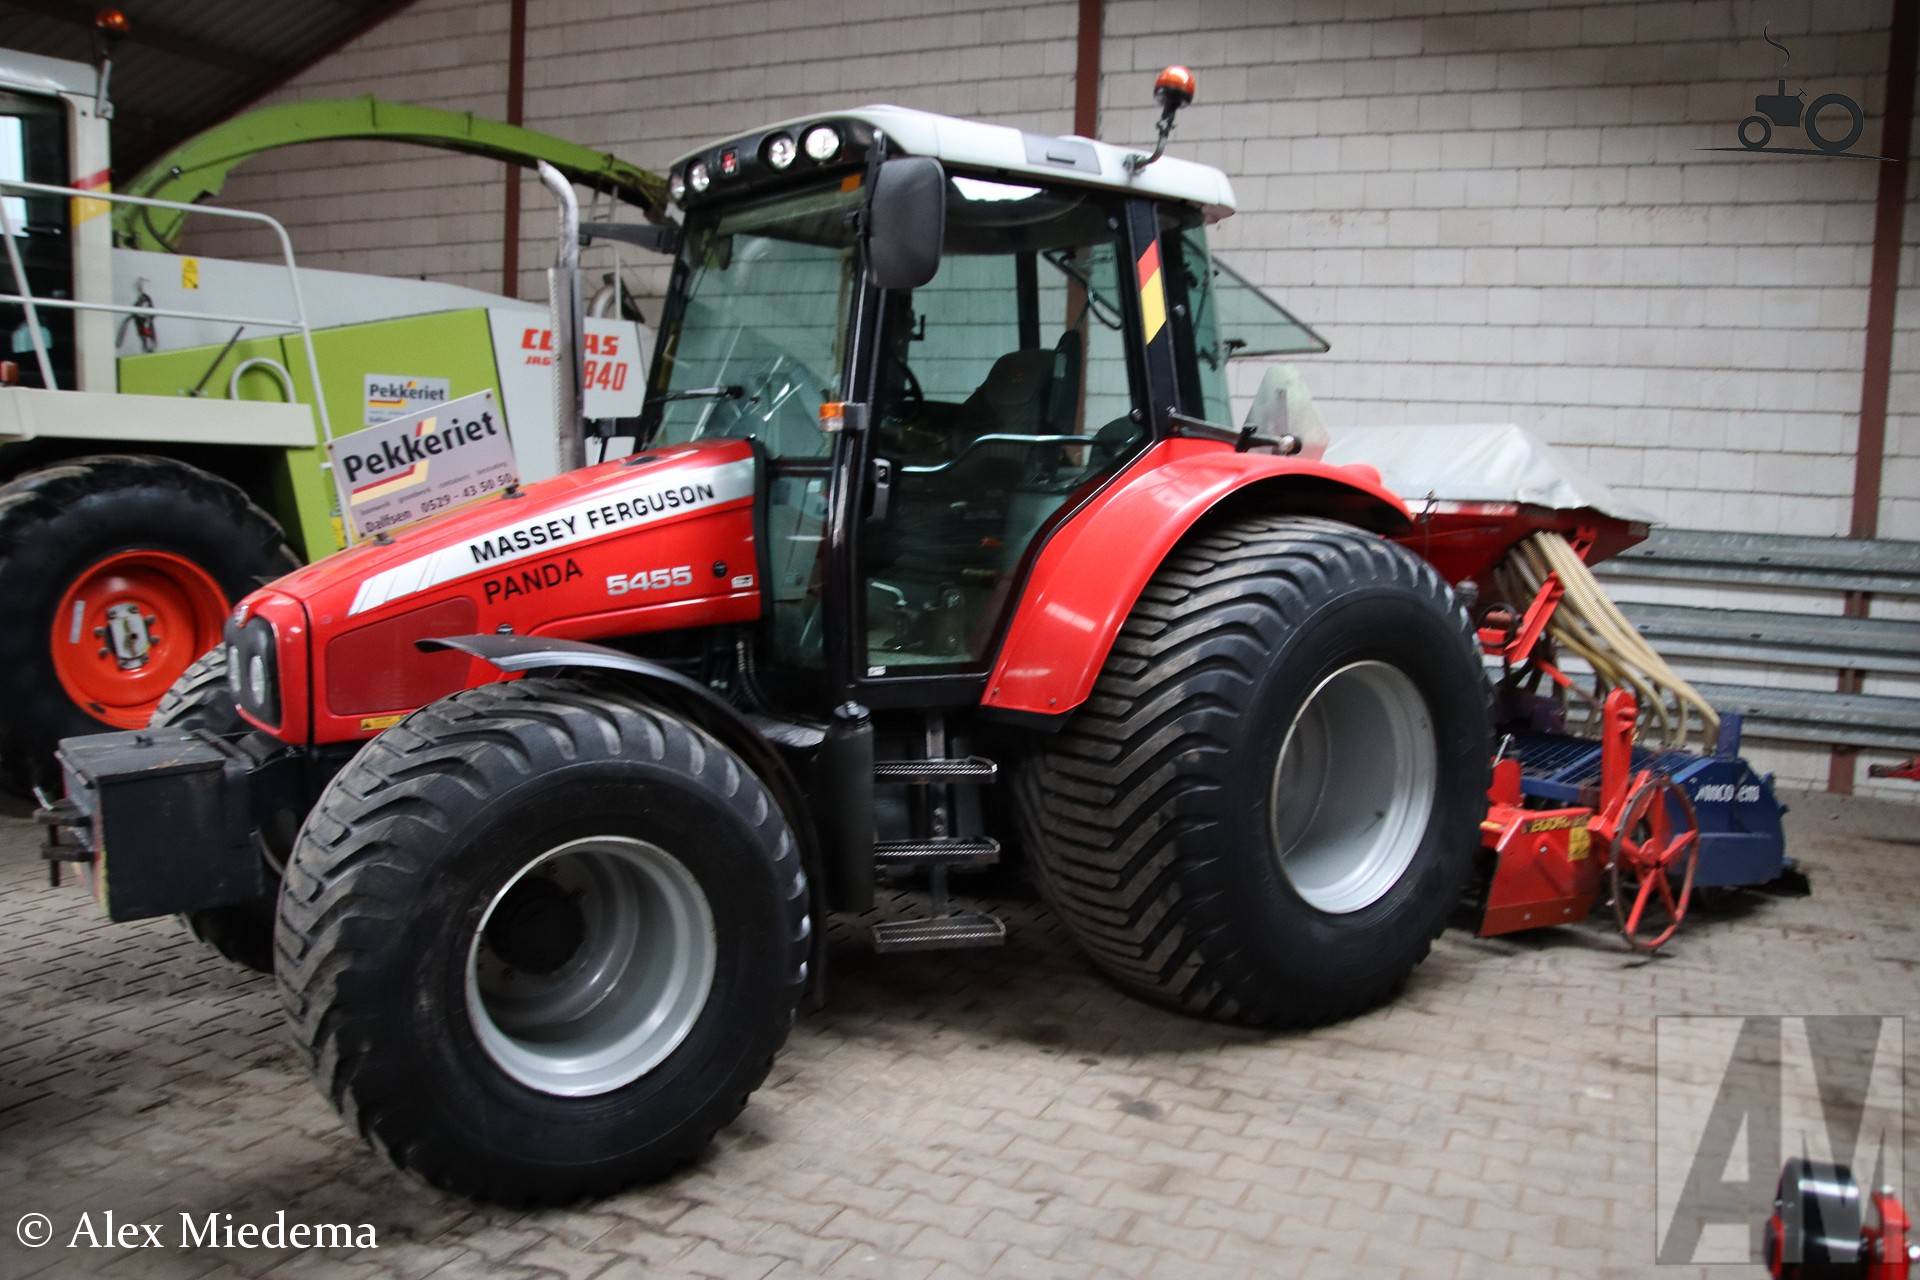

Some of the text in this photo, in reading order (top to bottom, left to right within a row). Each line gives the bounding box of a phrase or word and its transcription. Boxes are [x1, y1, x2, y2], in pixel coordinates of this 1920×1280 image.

[521, 327, 619, 357] CLAS
[369, 382, 445, 401] Pekkeriet
[583, 360, 628, 391] 840
[342, 411, 497, 482] Pekkeriet
[365, 509, 413, 533] Dalfsen
[420, 494, 451, 513] 0529
[462, 484, 479, 498] 43
[479, 480, 496, 492] 50
[497, 472, 514, 487] 50
[470, 483, 715, 564] MASSEY FERGUSON
[483, 557, 583, 605] PANDA
[606, 564, 693, 597] 5455
